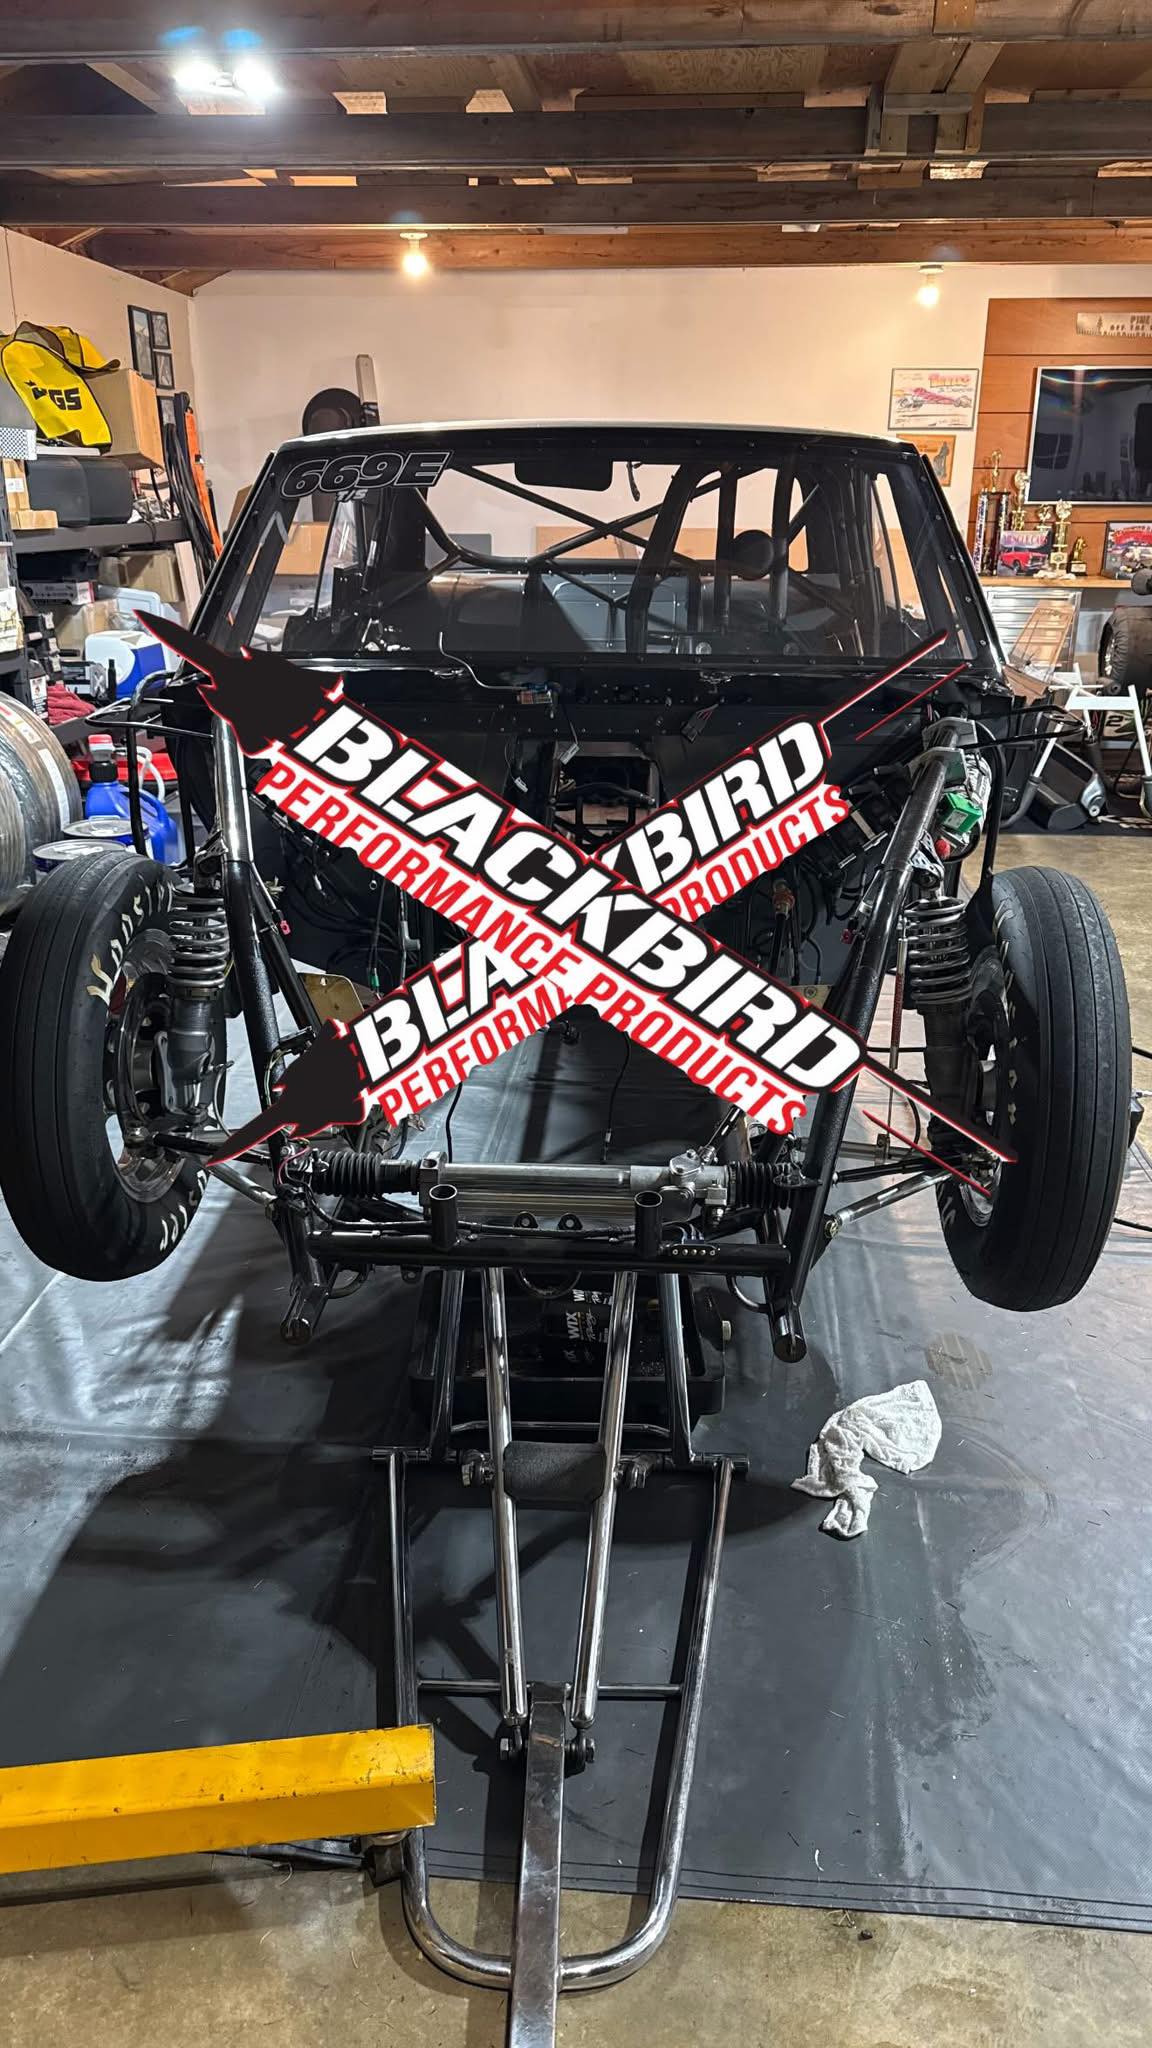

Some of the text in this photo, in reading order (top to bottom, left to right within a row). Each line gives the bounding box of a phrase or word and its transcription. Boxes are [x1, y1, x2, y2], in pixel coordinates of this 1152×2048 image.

[281, 451, 451, 498] 669E
[337, 488, 369, 501] T/S
[566, 1312, 580, 1339] WIX
